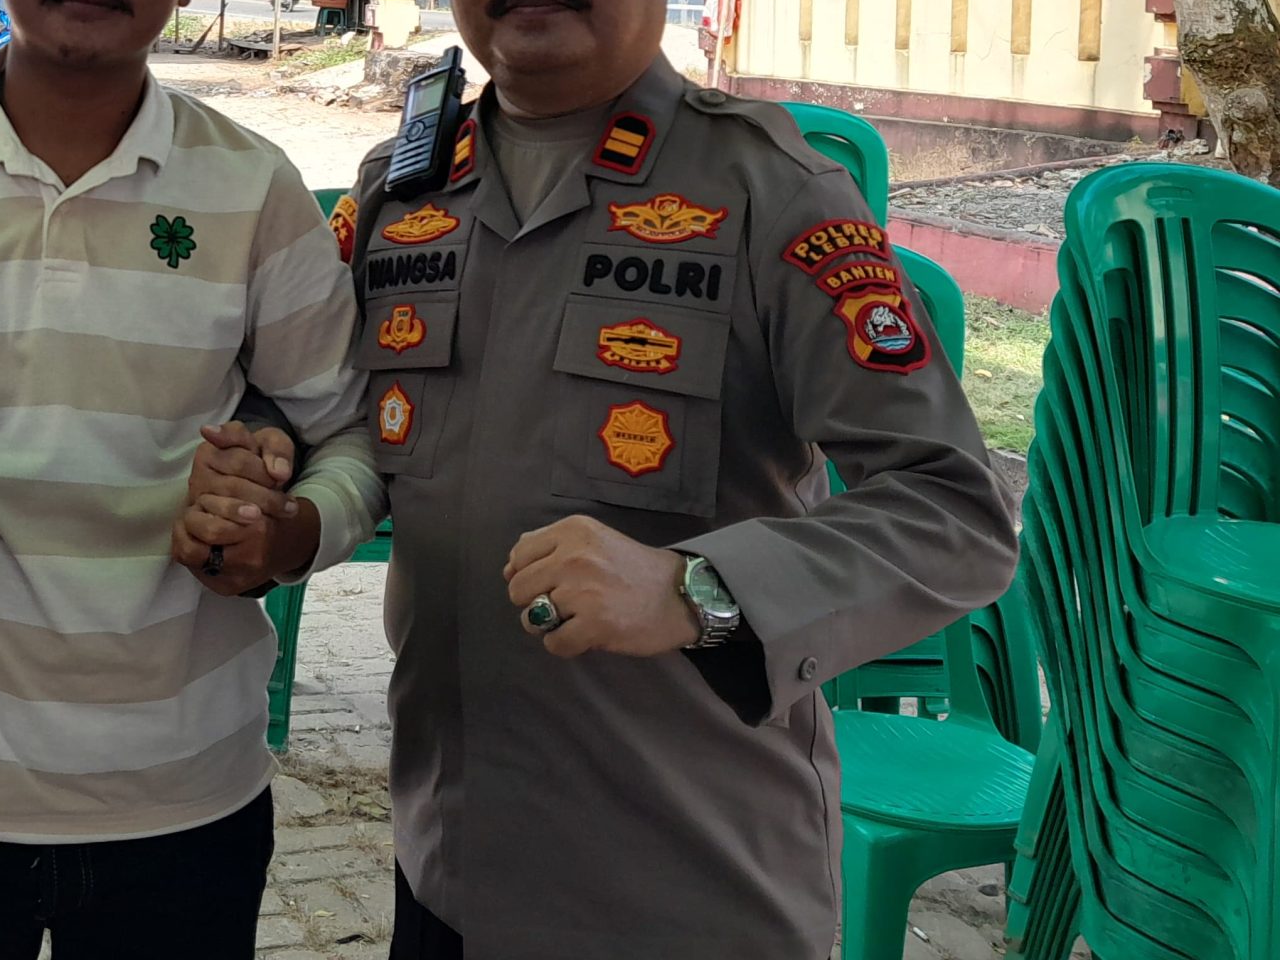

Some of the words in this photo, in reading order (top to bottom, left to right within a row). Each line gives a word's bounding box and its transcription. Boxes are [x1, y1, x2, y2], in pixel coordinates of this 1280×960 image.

[794, 223, 883, 258] POLRES
[583, 254, 722, 301] POLRI
[826, 266, 895, 288] BANTEN
